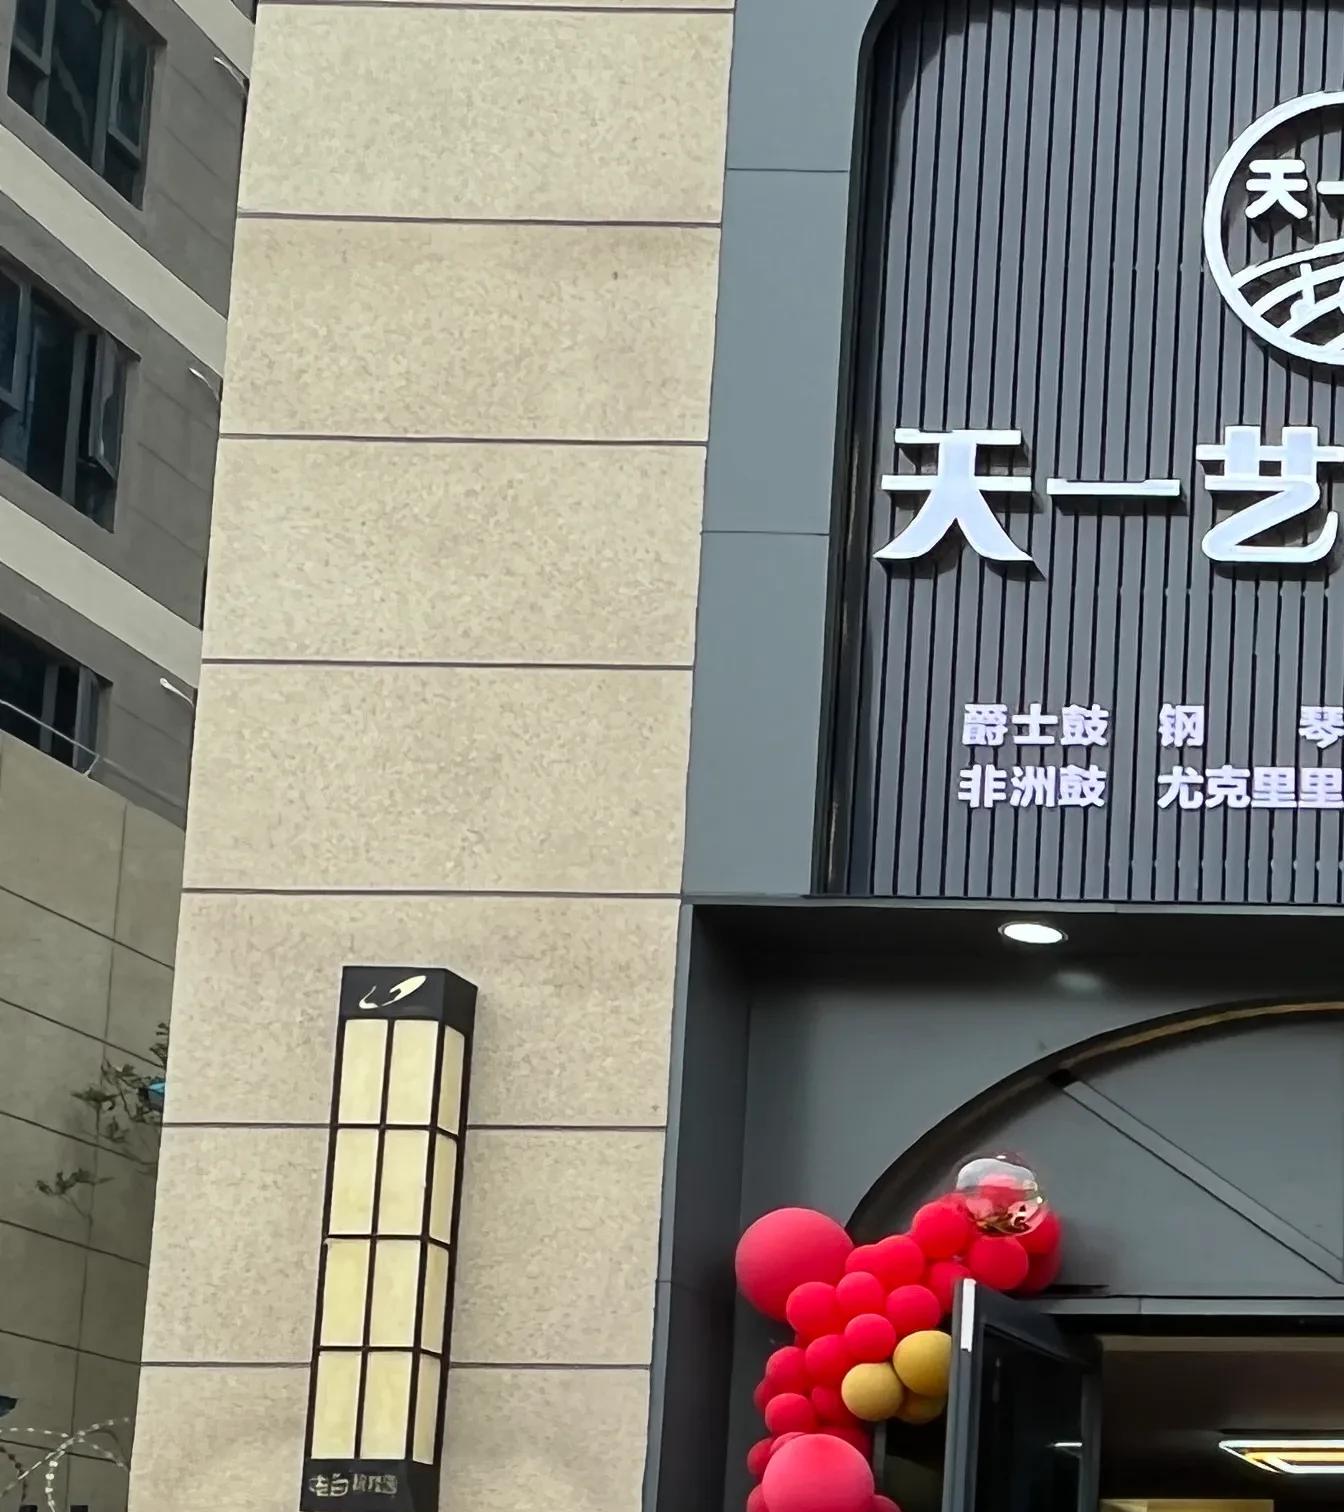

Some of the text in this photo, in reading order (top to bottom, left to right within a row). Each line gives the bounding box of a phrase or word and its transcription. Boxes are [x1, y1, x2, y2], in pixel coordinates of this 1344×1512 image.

[961, 703, 1109, 747] 爵士鼓
[957, 763, 1108, 809] 非洲鼓
